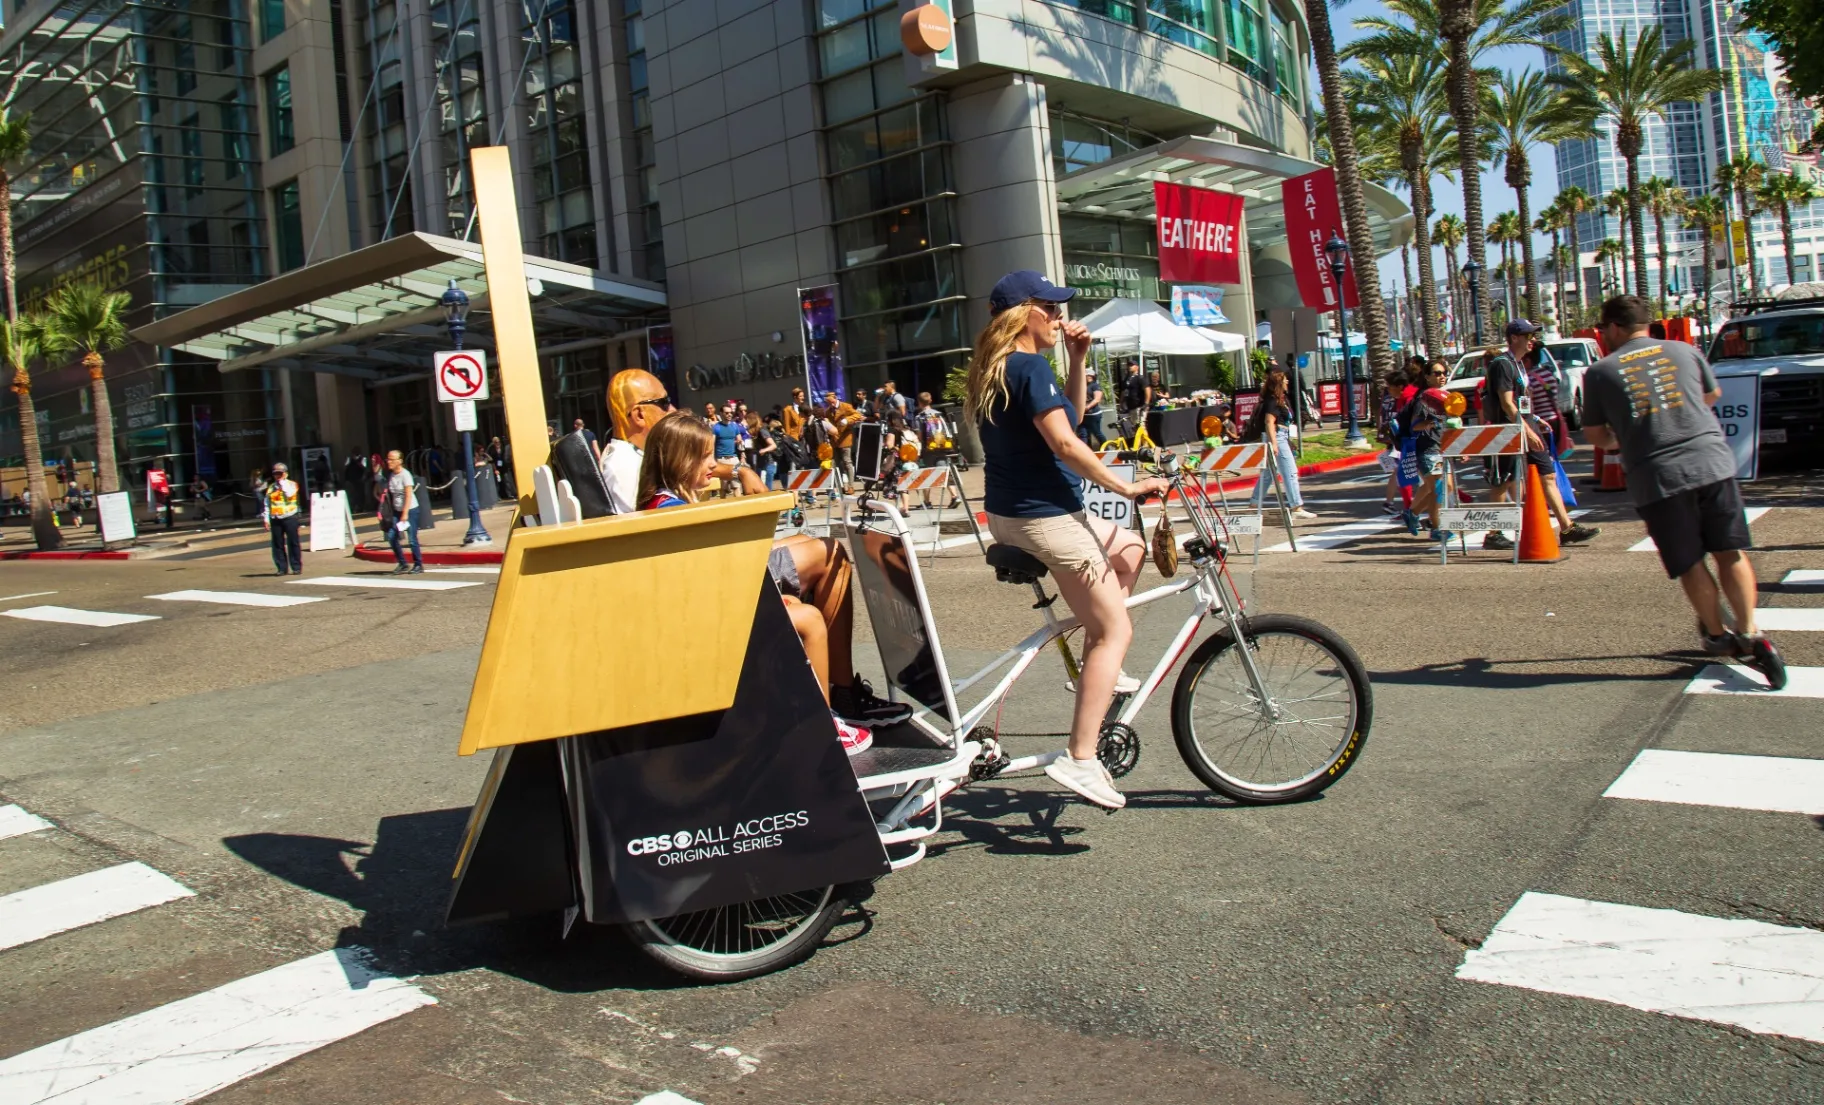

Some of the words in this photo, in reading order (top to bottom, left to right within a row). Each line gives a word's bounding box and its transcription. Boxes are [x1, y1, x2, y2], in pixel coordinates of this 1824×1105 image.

[1303, 178, 1317, 220] EAT
[1309, 229, 1330, 285] HERE
[1711, 404, 1749, 419] ABS
[1088, 501, 1127, 520] SED
[1463, 510, 1500, 521] ACME
[627, 834, 673, 856] CBS
[693, 825, 730, 846] ALL
[733, 810, 809, 839] ACCESS
[657, 844, 730, 867] ORIGINAL
[732, 834, 783, 854] SERIES
